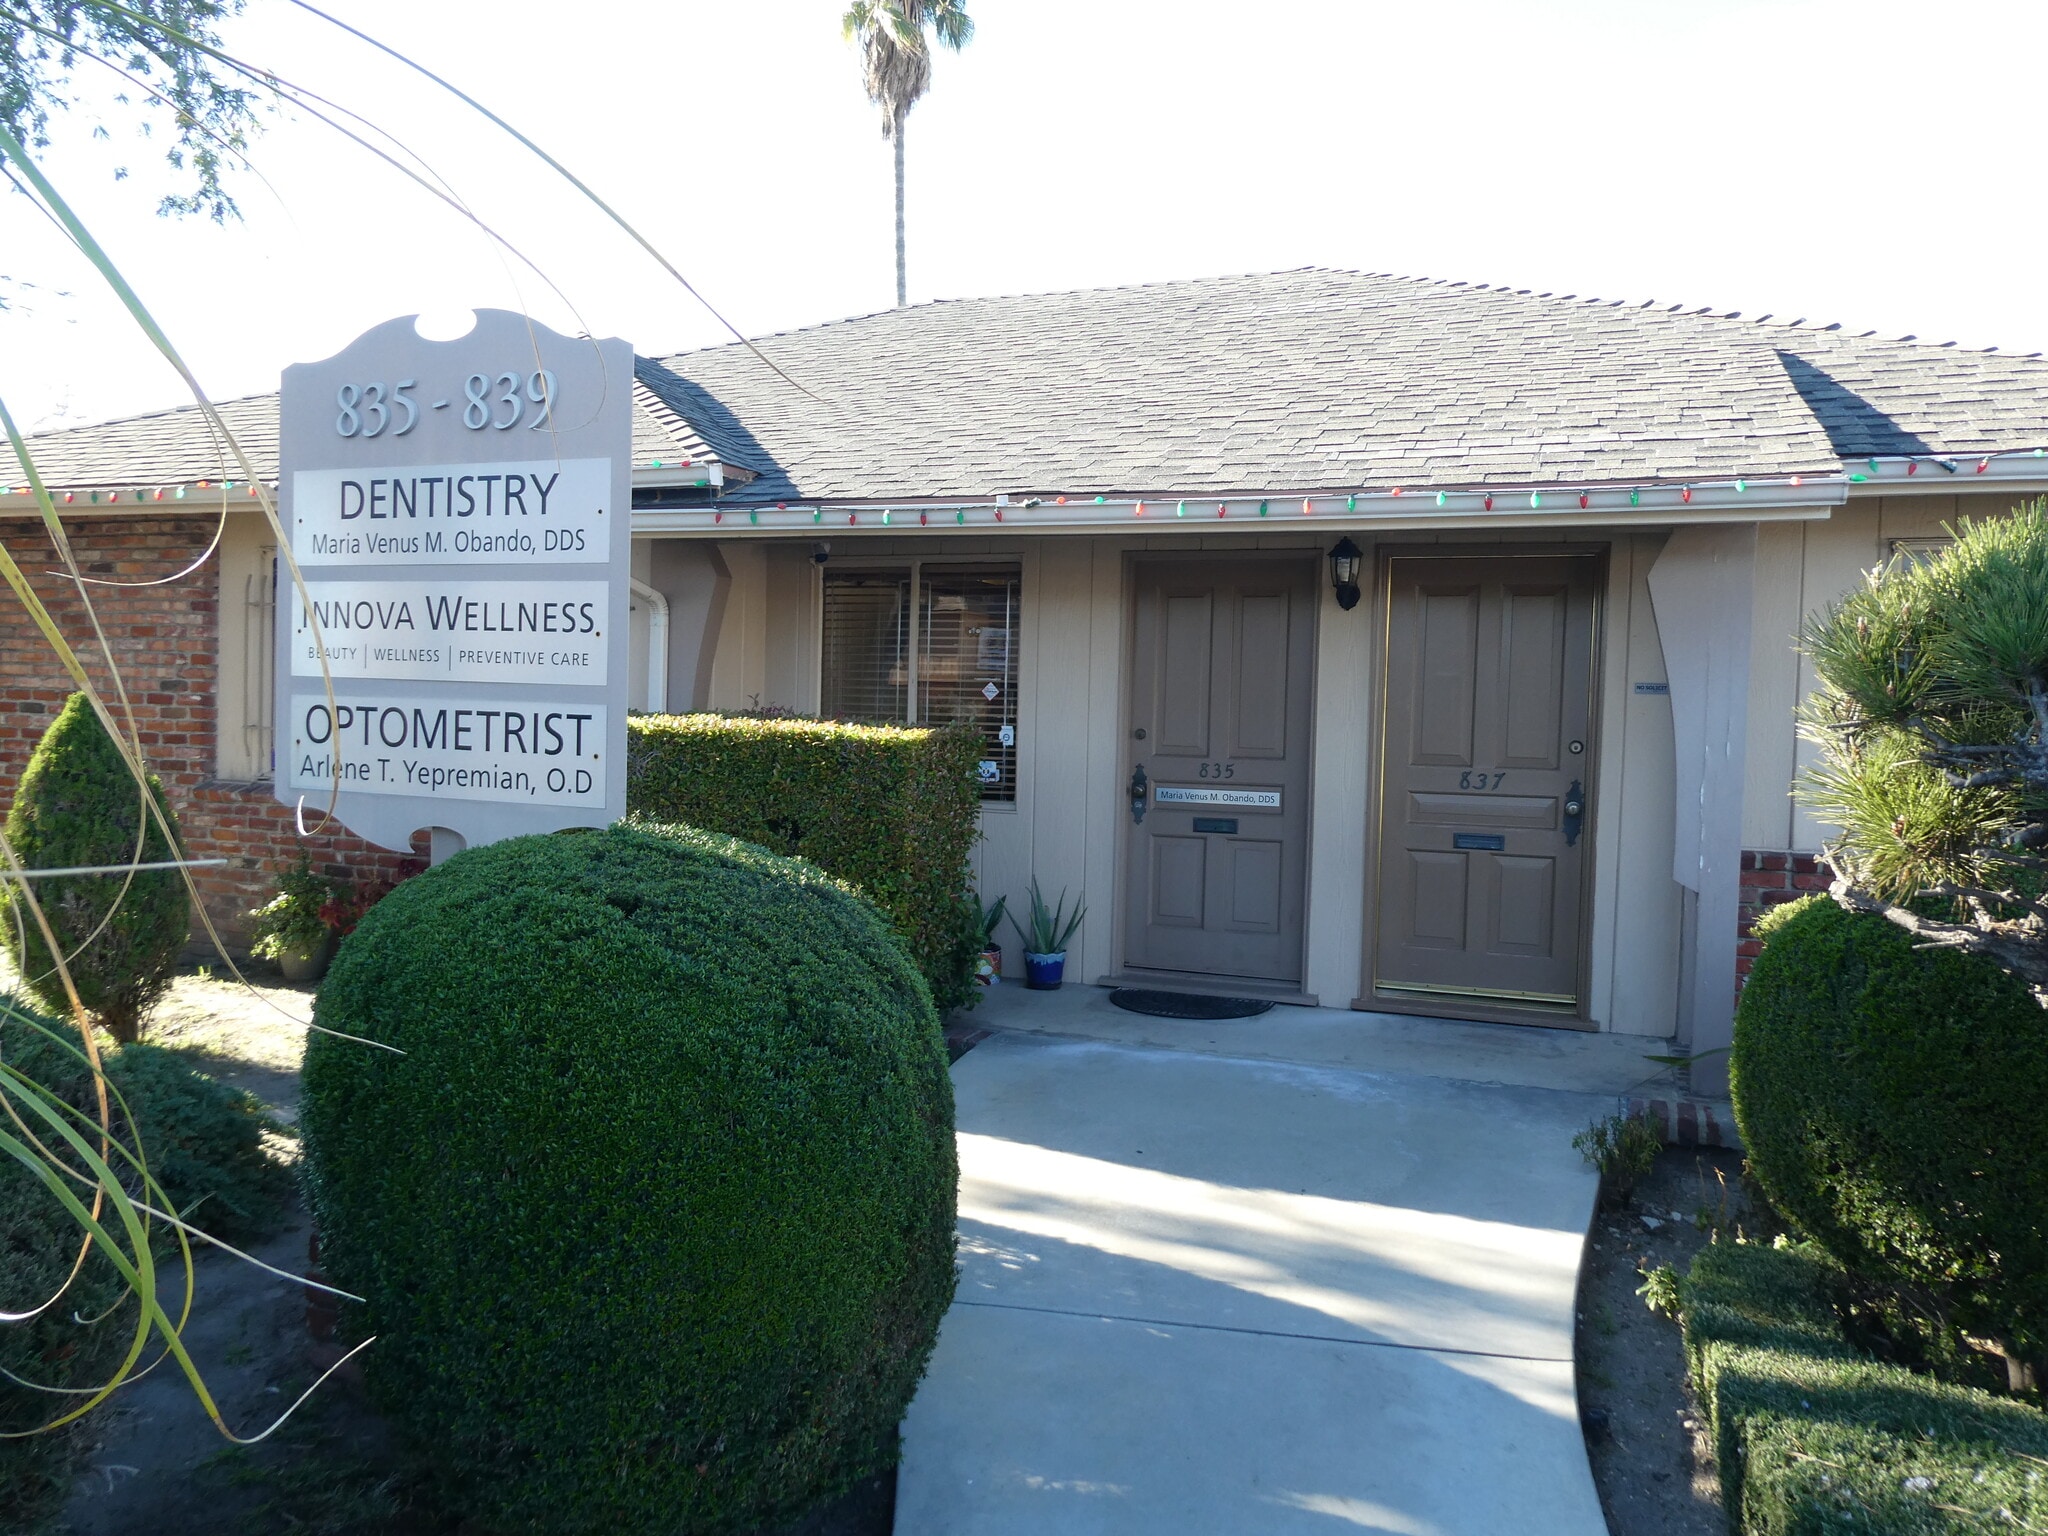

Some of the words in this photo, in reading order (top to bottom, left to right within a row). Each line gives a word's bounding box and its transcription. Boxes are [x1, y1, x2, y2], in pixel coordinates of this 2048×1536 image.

[336, 379, 420, 438] 835
[463, 369, 559, 430] 839
[340, 473, 560, 520] DENTISTRY
[312, 533, 363, 555] Maria
[366, 532, 419, 554] Venus
[425, 531, 447, 553] M.
[454, 529, 536, 556] Obando,
[544, 529, 586, 551] DDS
[303, 601, 415, 630] INNOVA
[425, 596, 595, 633] WELLNESS
[308, 646, 357, 660] BEAUTY
[374, 648, 440, 663] WELLNESS
[459, 650, 545, 666] PREVENTIVE
[551, 652, 590, 667] CARE
[306, 704, 593, 757] OPTOMETRIST
[300, 754, 370, 781] Arlene
[377, 758, 394, 783] T.
[402, 759, 536, 796] Yepremian,
[547, 768, 593, 794] O.D
[1199, 762, 1235, 779] 835
[1460, 770, 1506, 791] 837
[1160, 790, 1183, 800] Maria
[1185, 791, 1208, 801] Venus
[1210, 793, 1219, 801] M.
[1222, 793, 1256, 804] Obando,
[1258, 794, 1275, 804] DDS
